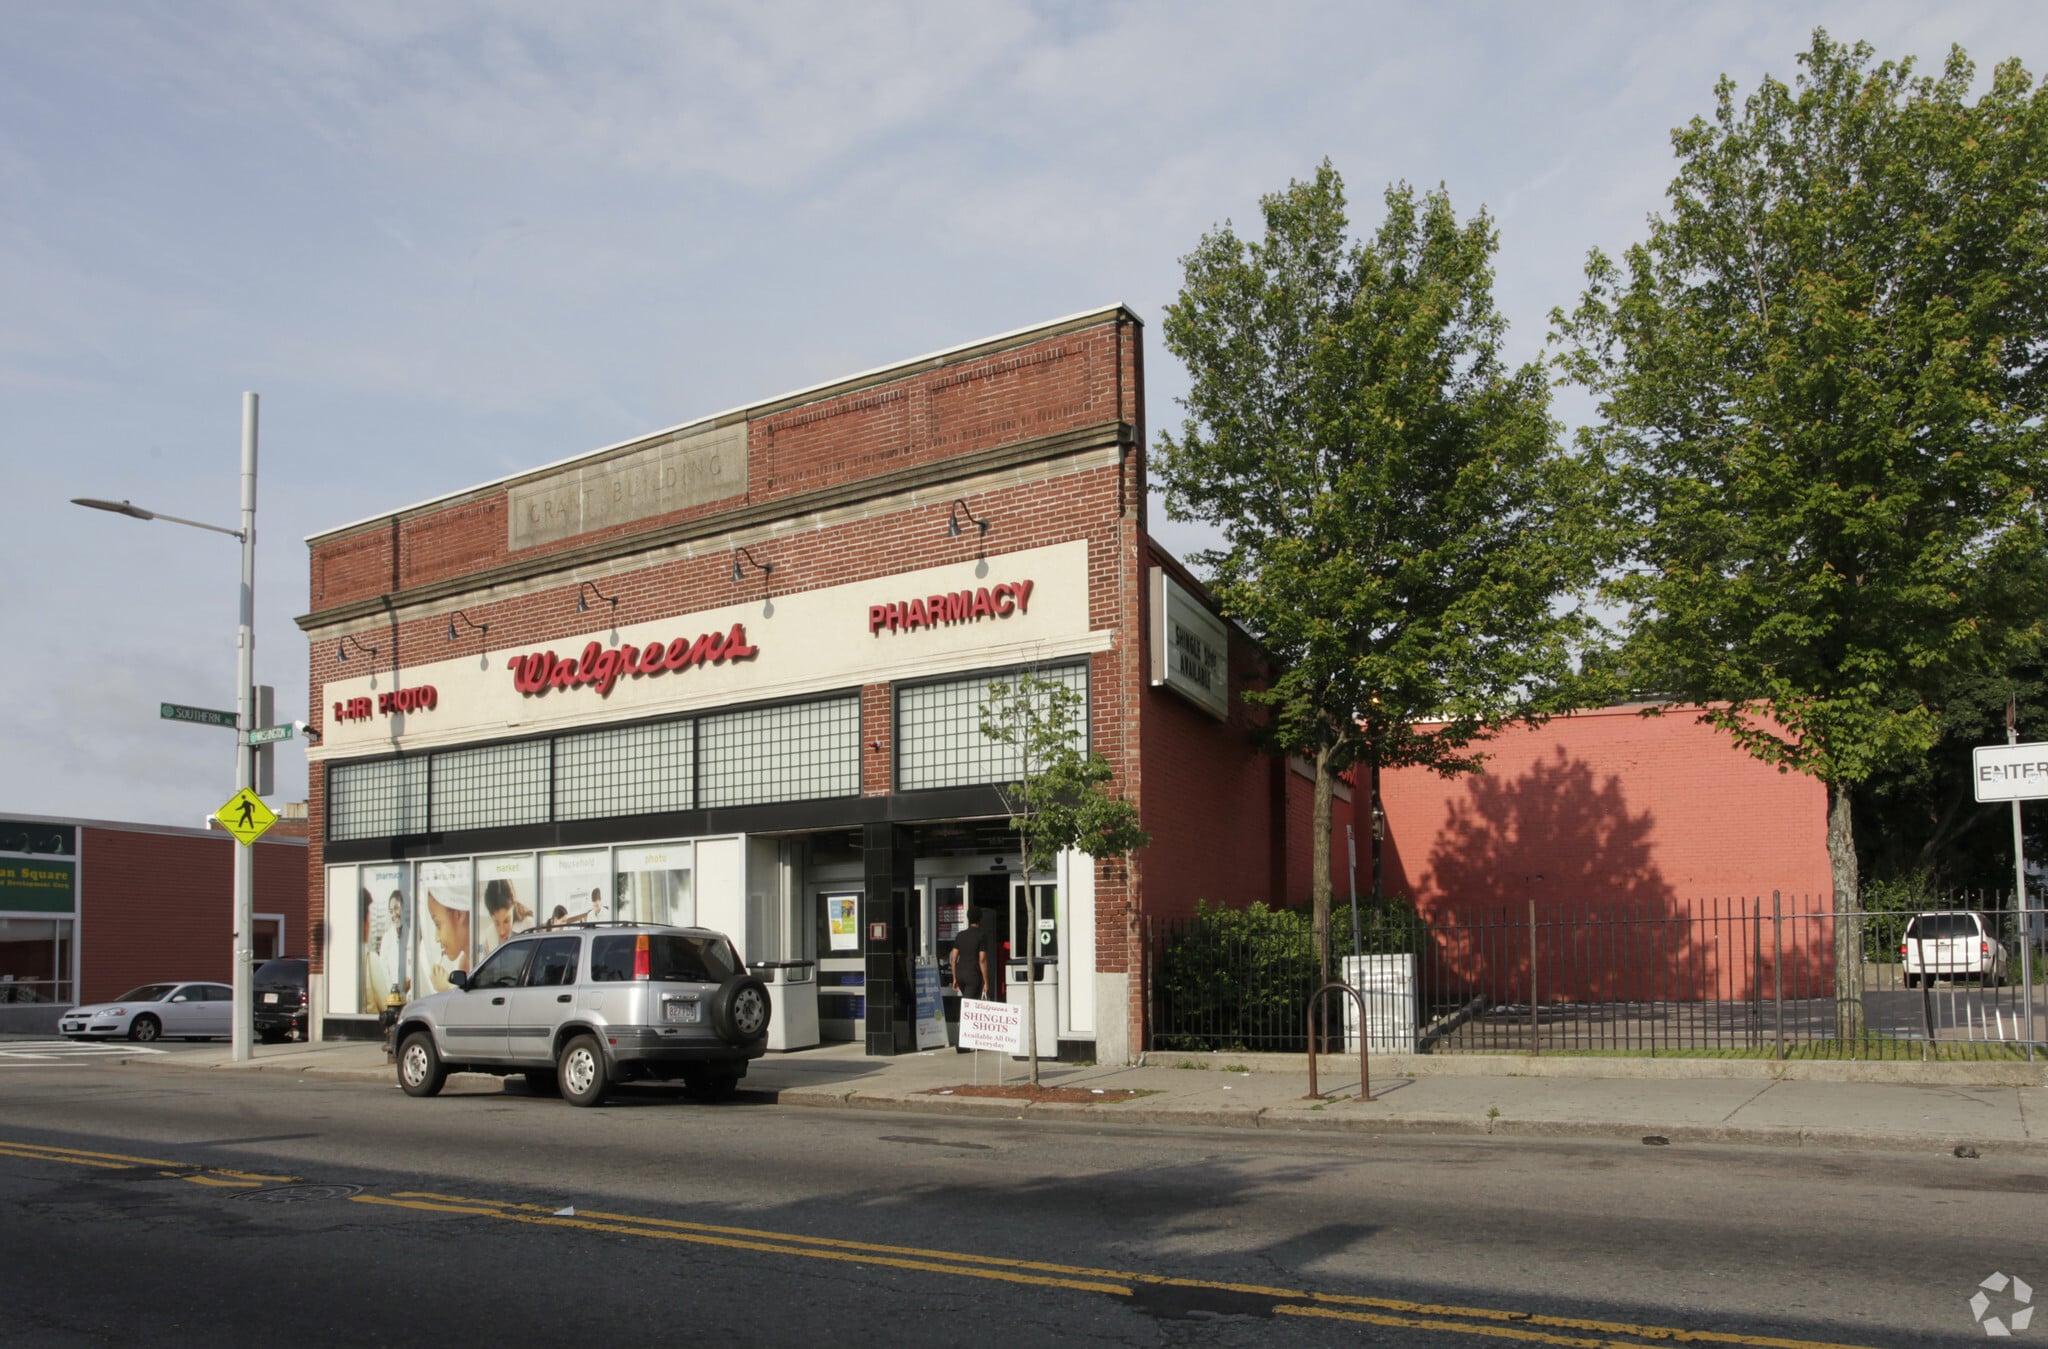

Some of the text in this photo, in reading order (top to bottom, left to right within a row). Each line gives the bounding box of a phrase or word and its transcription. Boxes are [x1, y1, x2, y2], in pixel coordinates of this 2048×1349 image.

[613, 455, 721, 502] BUILDING
[869, 579, 1034, 634] PHARMACY
[508, 623, 757, 698] Walgreens
[332, 685, 438, 723] 1-HR PHOTO
[175, 708, 221, 723] SOUTHERN
[559, 857, 595, 870] household
[644, 853, 667, 864] photo
[21, 867, 69, 881] Square
[496, 863, 520, 873] market
[963, 1011, 1018, 1025] SHINGLES
[972, 1021, 1009, 1033] SHOTS
[962, 1032, 993, 1041] Available
